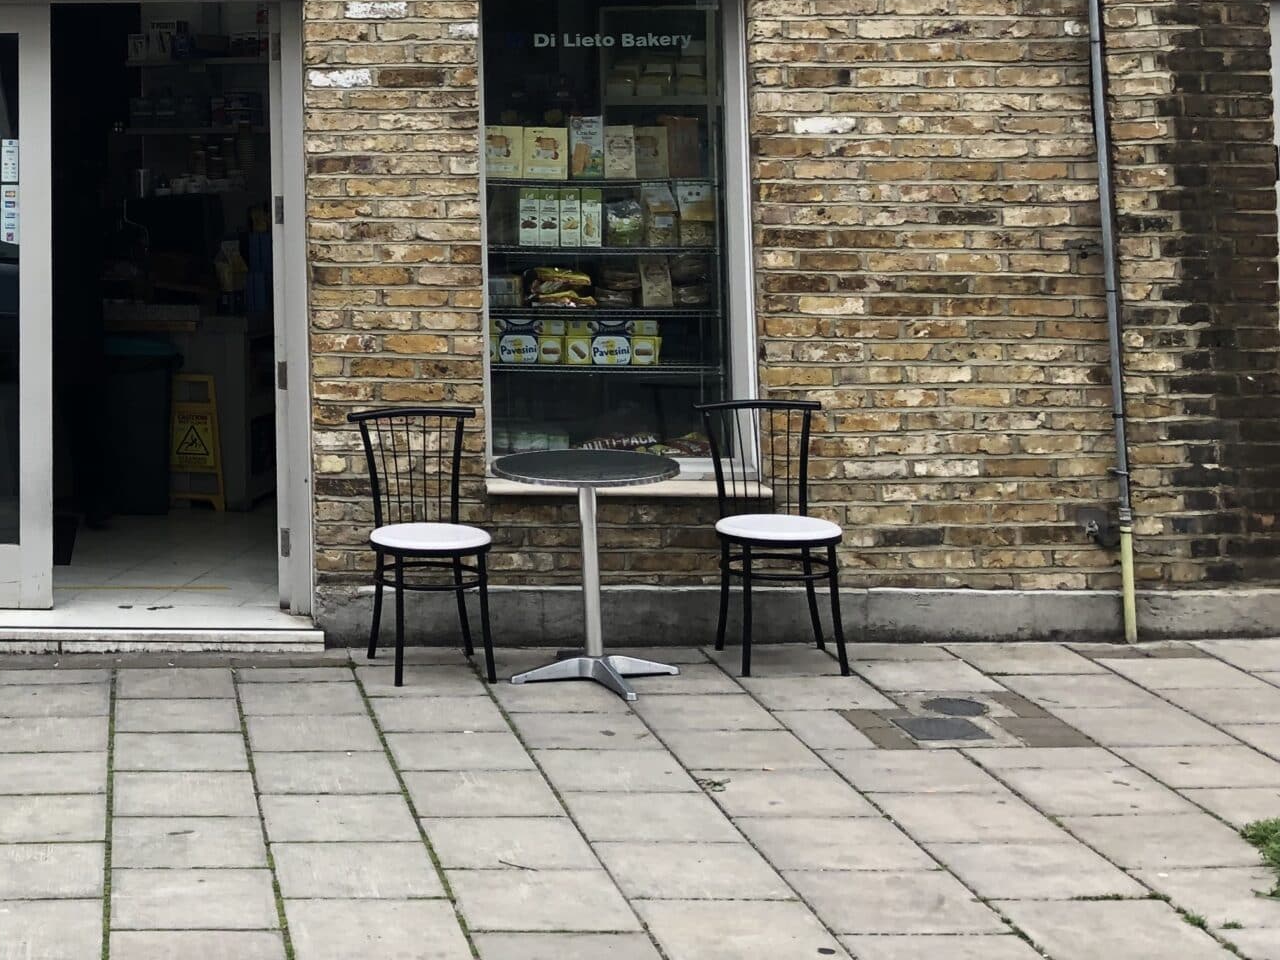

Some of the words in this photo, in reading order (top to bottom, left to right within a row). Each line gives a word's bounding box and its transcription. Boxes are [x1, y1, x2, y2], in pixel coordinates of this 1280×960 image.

[533, 33, 556, 48] Di
[563, 33, 616, 48] Lieto
[621, 33, 692, 49] Bakery
[500, 343, 537, 356] Pavesini
[593, 344, 630, 358] Pavesini
